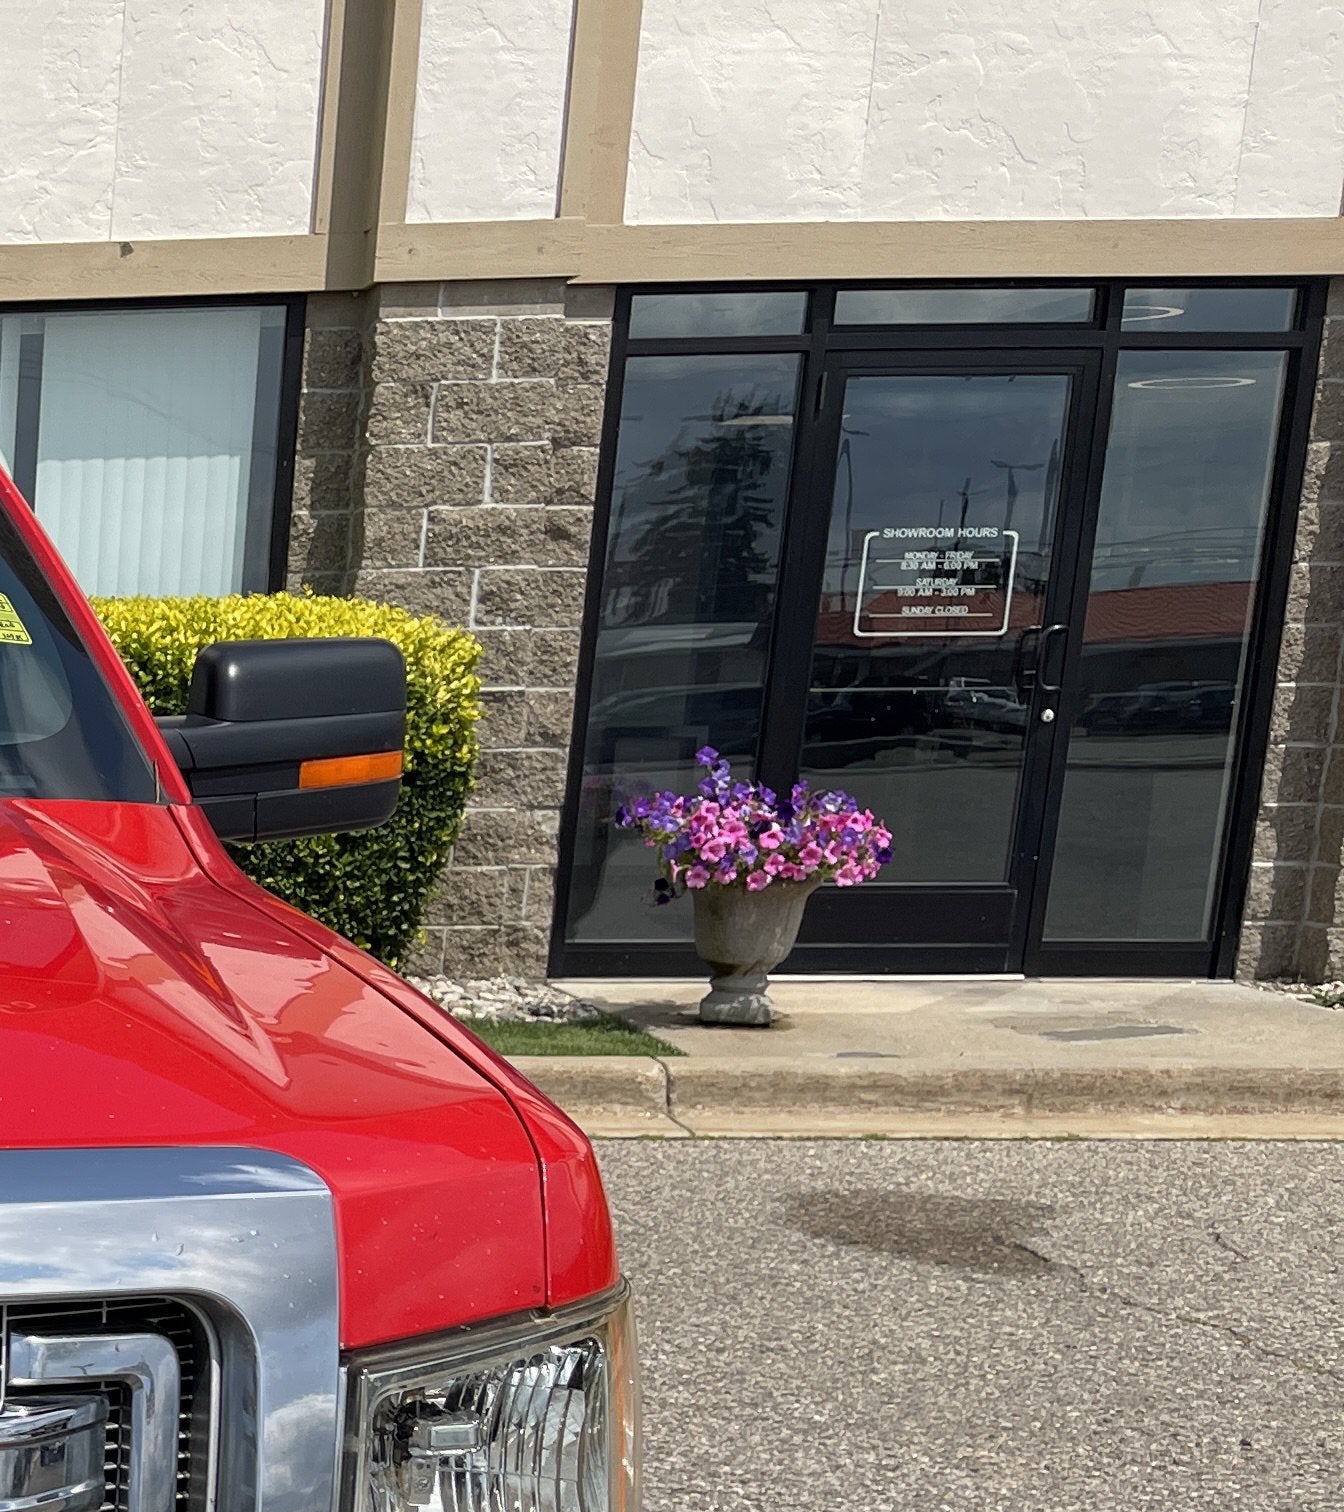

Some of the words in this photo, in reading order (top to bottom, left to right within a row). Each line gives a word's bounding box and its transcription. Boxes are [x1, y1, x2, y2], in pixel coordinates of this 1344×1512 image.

[883, 527, 954, 538] SHOWROOM
[957, 527, 999, 538] HOURS
[904, 551, 939, 560] MONDAY
[945, 551, 974, 560] FRIDAY
[920, 561, 937, 570] AM
[963, 561, 979, 570] PM
[915, 578, 959, 587] SATURDAY
[917, 588, 933, 597] AM
[960, 588, 976, 597] PM
[901, 606, 934, 615] SUNDAY
[934, 605, 969, 615] CLOSED
